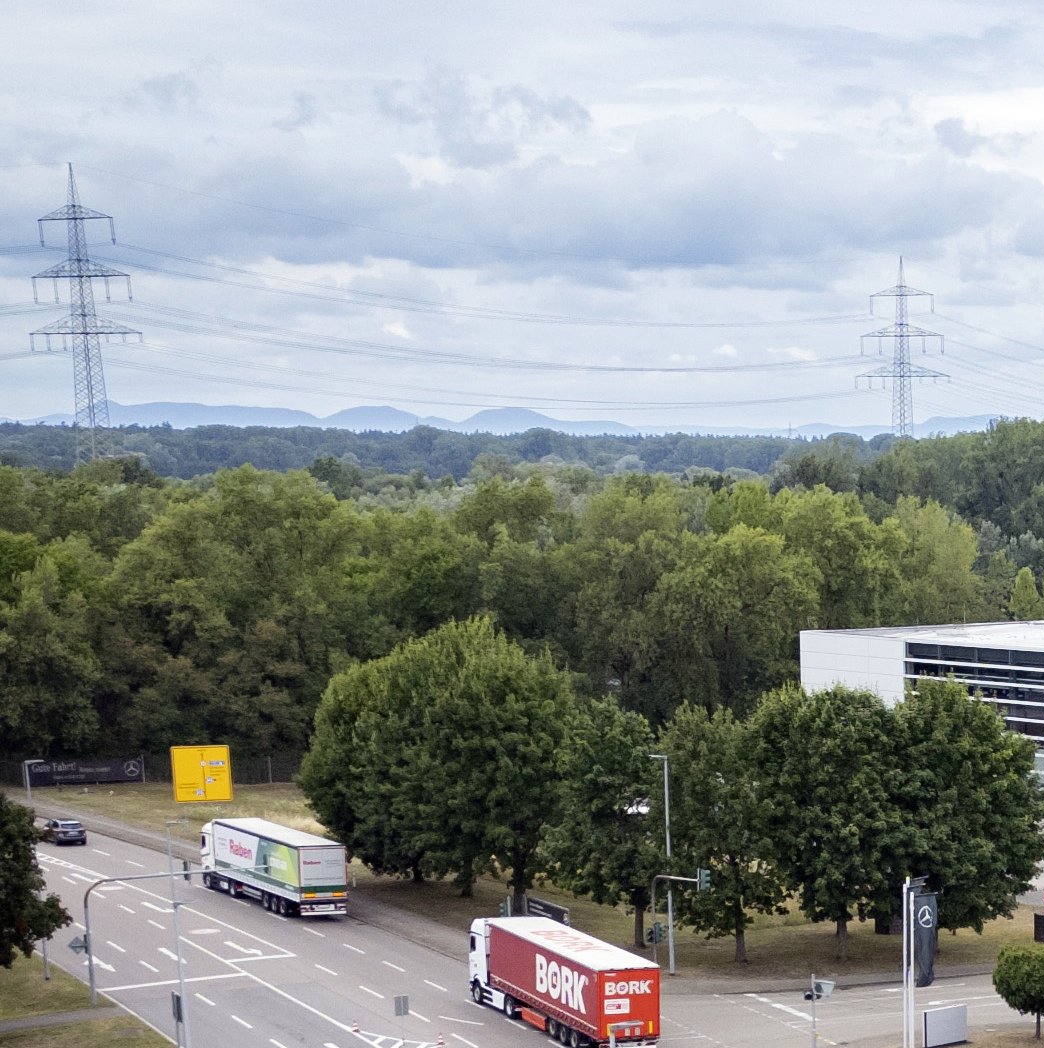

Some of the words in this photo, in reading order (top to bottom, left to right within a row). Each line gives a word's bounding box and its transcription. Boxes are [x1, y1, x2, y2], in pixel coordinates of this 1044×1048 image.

[31, 763, 51, 773] Gute
[229, 839, 253, 860] Raben
[536, 953, 587, 1014] BORK
[604, 980, 652, 996] BORK
